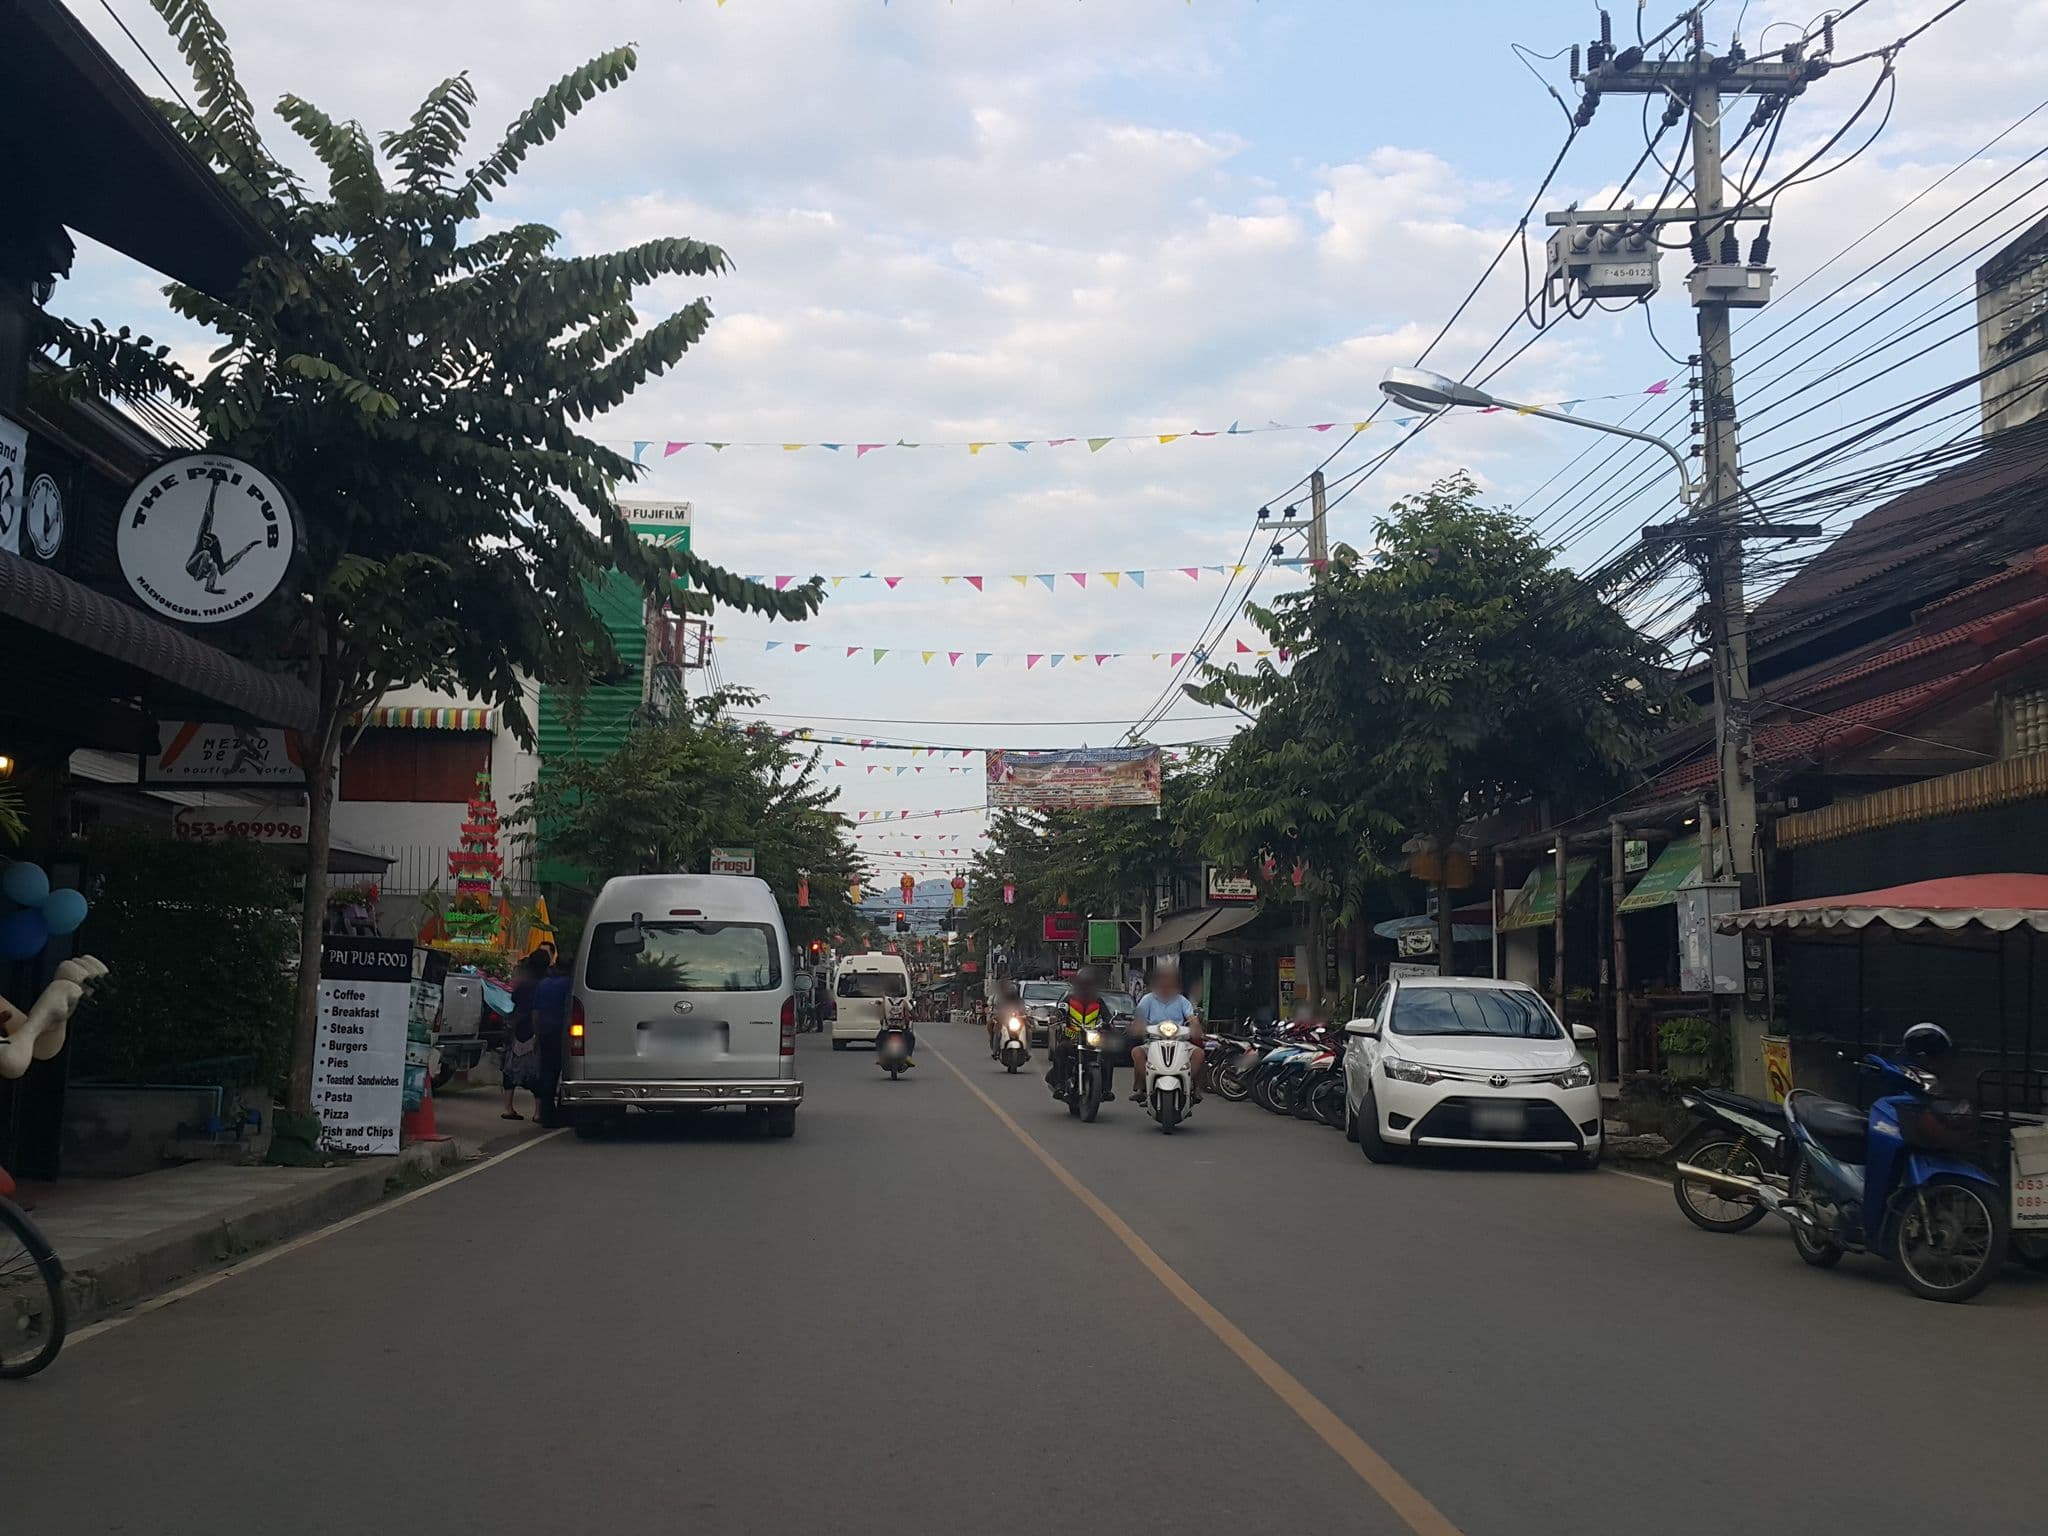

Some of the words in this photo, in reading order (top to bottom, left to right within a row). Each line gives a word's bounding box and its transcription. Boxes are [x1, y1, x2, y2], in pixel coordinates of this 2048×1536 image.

[132, 474, 179, 529] THE
[186, 467, 242, 486] PAI
[246, 484, 279, 549] PUB
[633, 508, 685, 520] FUJIFILM
[203, 591, 255, 617] THAILAND
[329, 949, 348, 965] PAI
[351, 950, 375, 966] PUB
[378, 952, 407, 967] FOOD
[333, 989, 366, 1001] Coffee
[331, 1006, 380, 1018] Breakfast
[330, 1022, 365, 1035] Steaks
[328, 1039, 368, 1053] Burgers
[327, 1057, 349, 1068] Pies
[326, 1074, 354, 1085] Toasted
[357, 1075, 399, 1086] Sandwiches
[324, 1091, 353, 1102] Pasta
[323, 1108, 349, 1120] Pizza
[321, 1126, 343, 1137] Fish
[345, 1126, 364, 1137] and
[366, 1126, 394, 1139] Chips
[346, 1143, 370, 1152] Food
